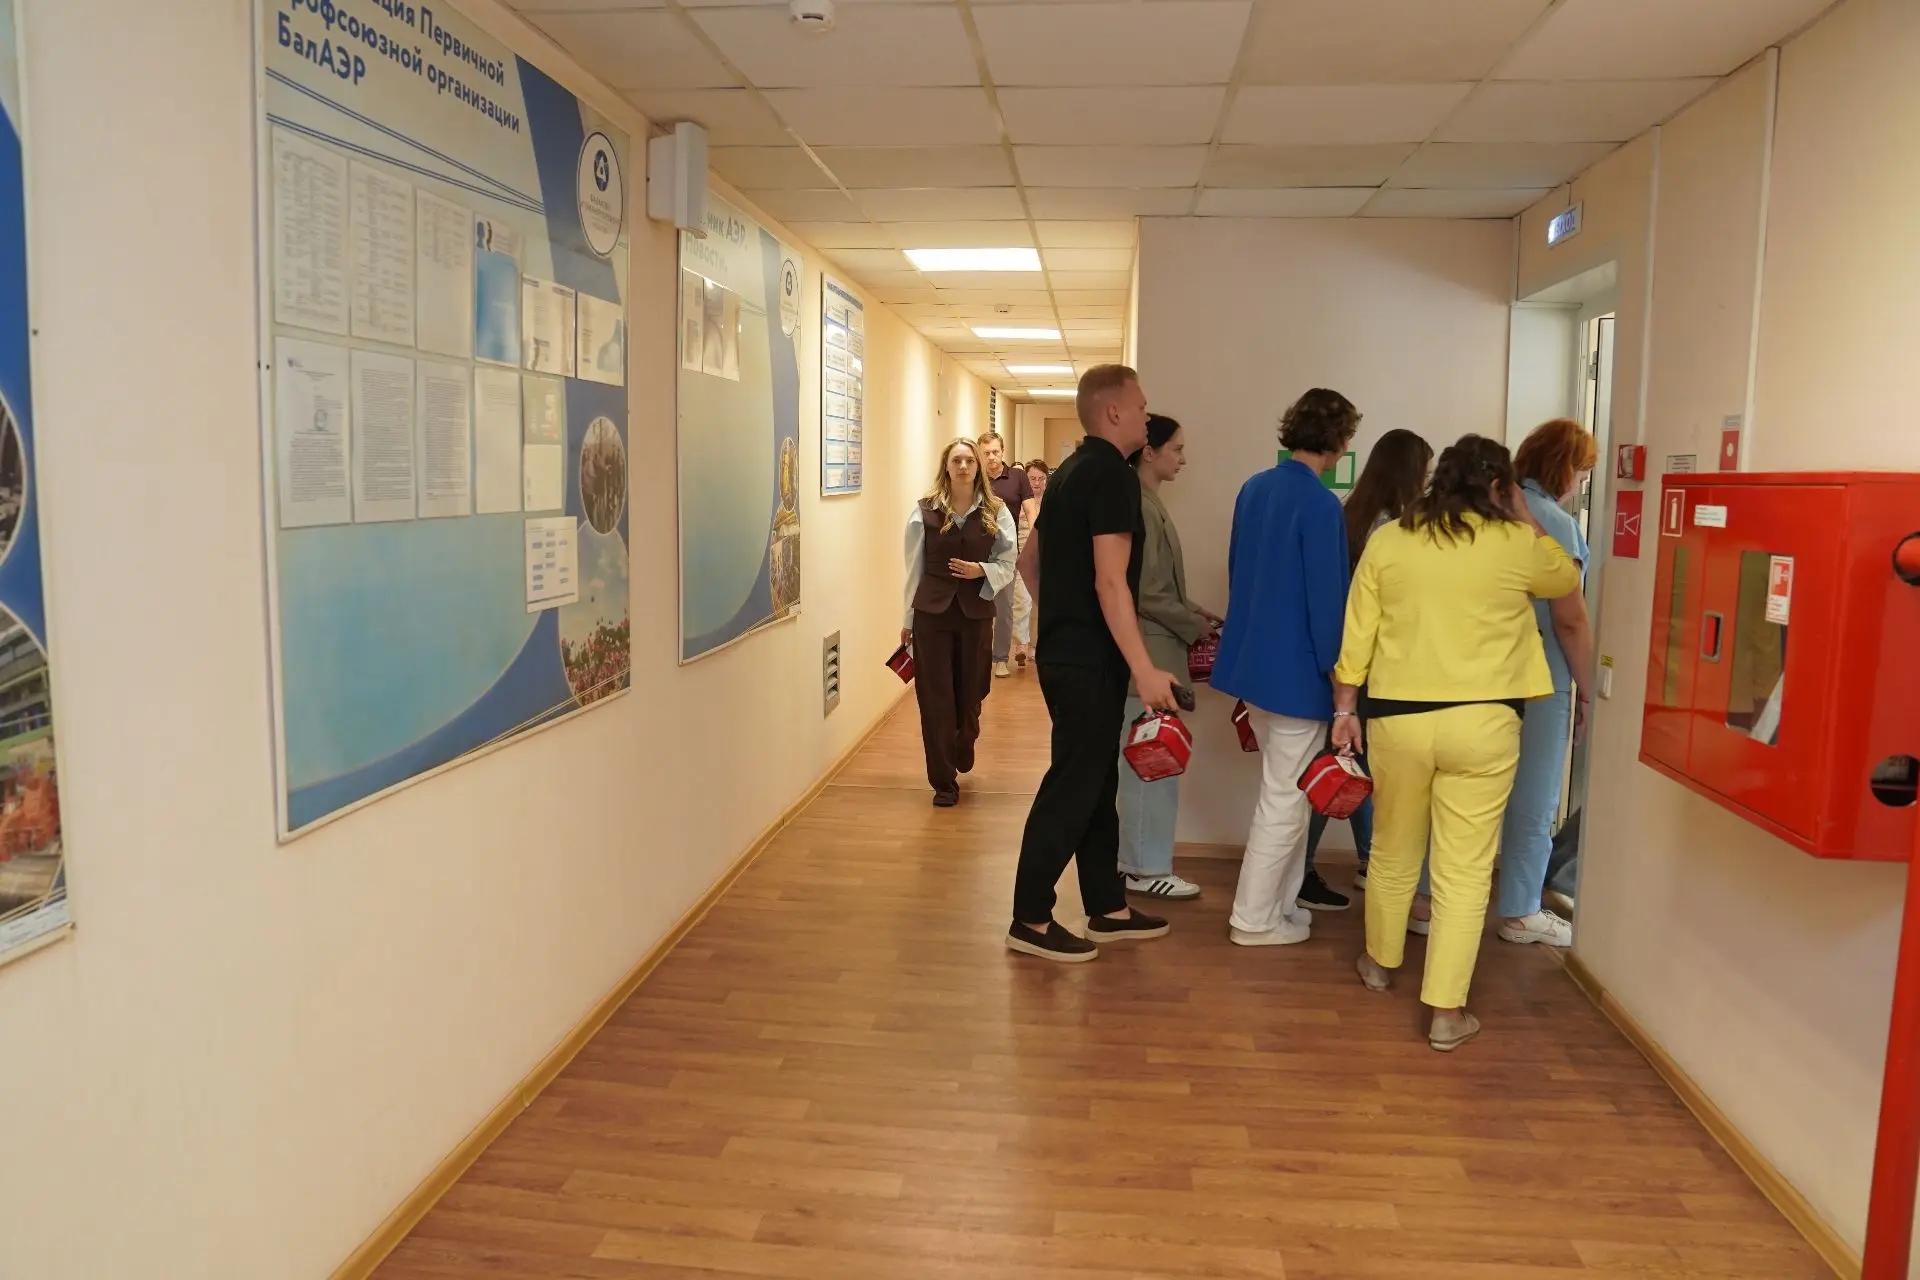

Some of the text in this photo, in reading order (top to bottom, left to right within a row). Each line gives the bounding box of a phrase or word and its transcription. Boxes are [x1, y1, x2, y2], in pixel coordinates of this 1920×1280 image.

[278, 11, 366, 86] БалАЭР
[420, 6, 504, 86] Первичной
[427, 64, 520, 133] организации
